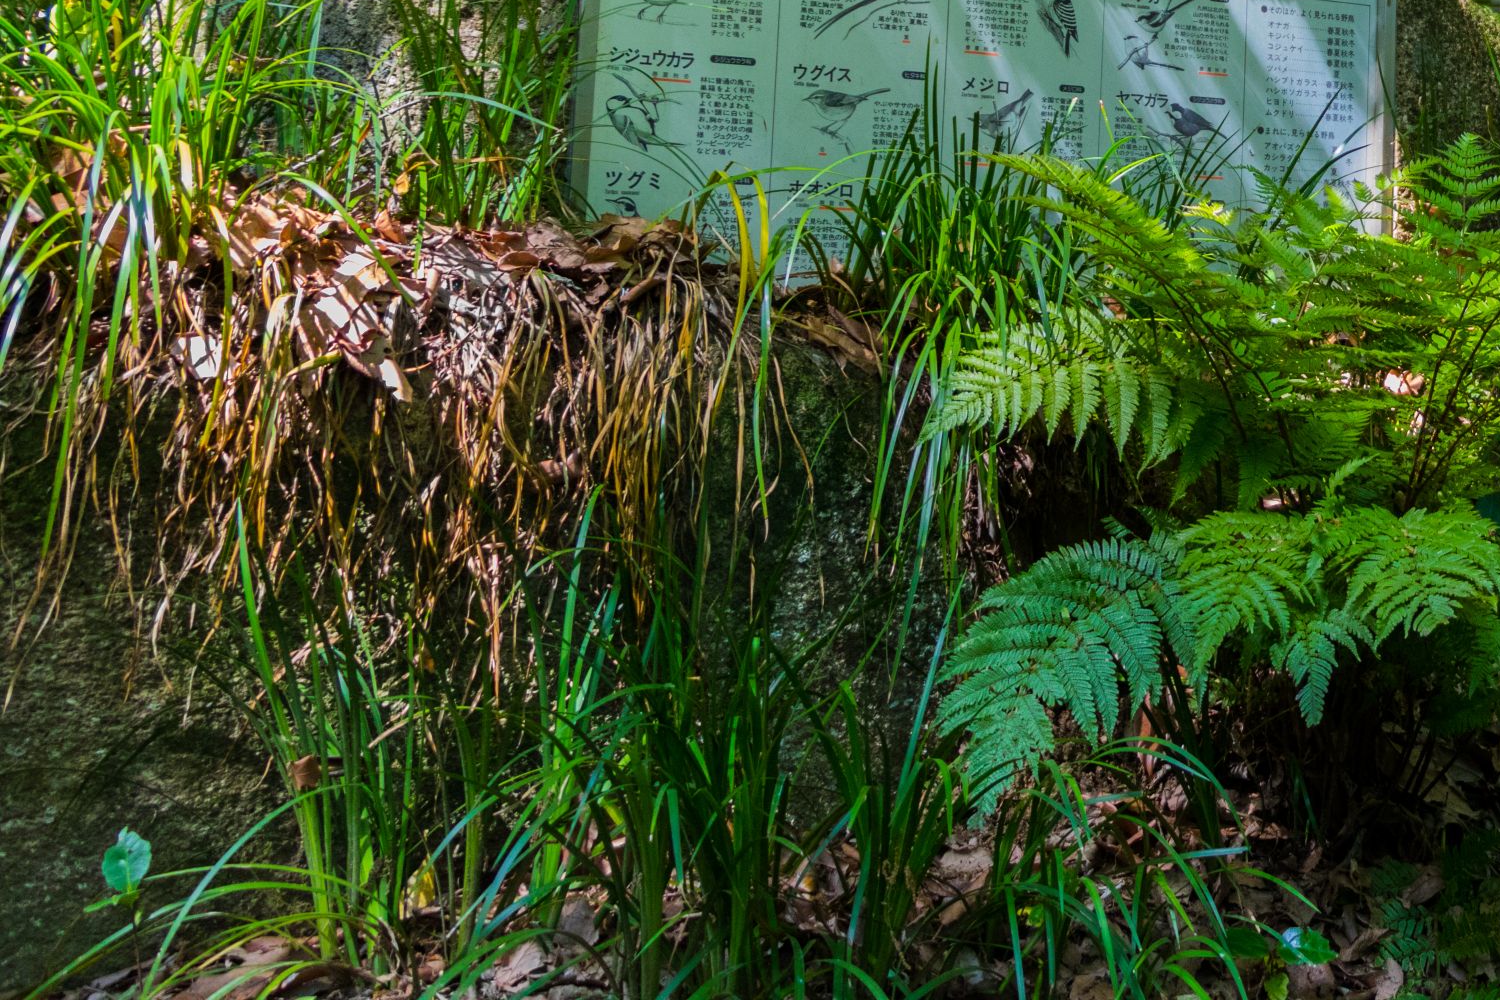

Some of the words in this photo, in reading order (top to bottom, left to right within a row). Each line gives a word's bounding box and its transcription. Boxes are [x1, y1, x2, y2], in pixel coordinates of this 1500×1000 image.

[1269, 7, 1354, 23] そのほか、よく見られる野鳥
[1268, 21, 1290, 29] オナガ
[1328, 27, 1355, 37] 春夏秋冬
[1268, 32, 1296, 40] キジバト
[1327, 38, 1355, 48] 春夏秋冬
[610, 47, 695, 68] シジュウカラ
[1268, 43, 1303, 53] コジュケイ
[1327, 49, 1355, 58] 春夏秋冬
[1267, 54, 1288, 62] スズメ
[1327, 59, 1354, 69] 春夏秋冬
[794, 64, 851, 82] ウグイス
[1266, 76, 1318, 86] ハシブトガラス
[962, 77, 1009, 94] メジロ
[1266, 87, 1318, 97] ハシボソガラス
[1116, 91, 1169, 108] ヤマガラ
[1267, 98, 1294, 106] ヒヨドリ
[1265, 109, 1294, 118] ムクドリ
[1265, 128, 1334, 140] まれに、見らる野鳥
[606, 171, 660, 190] ツグミ
